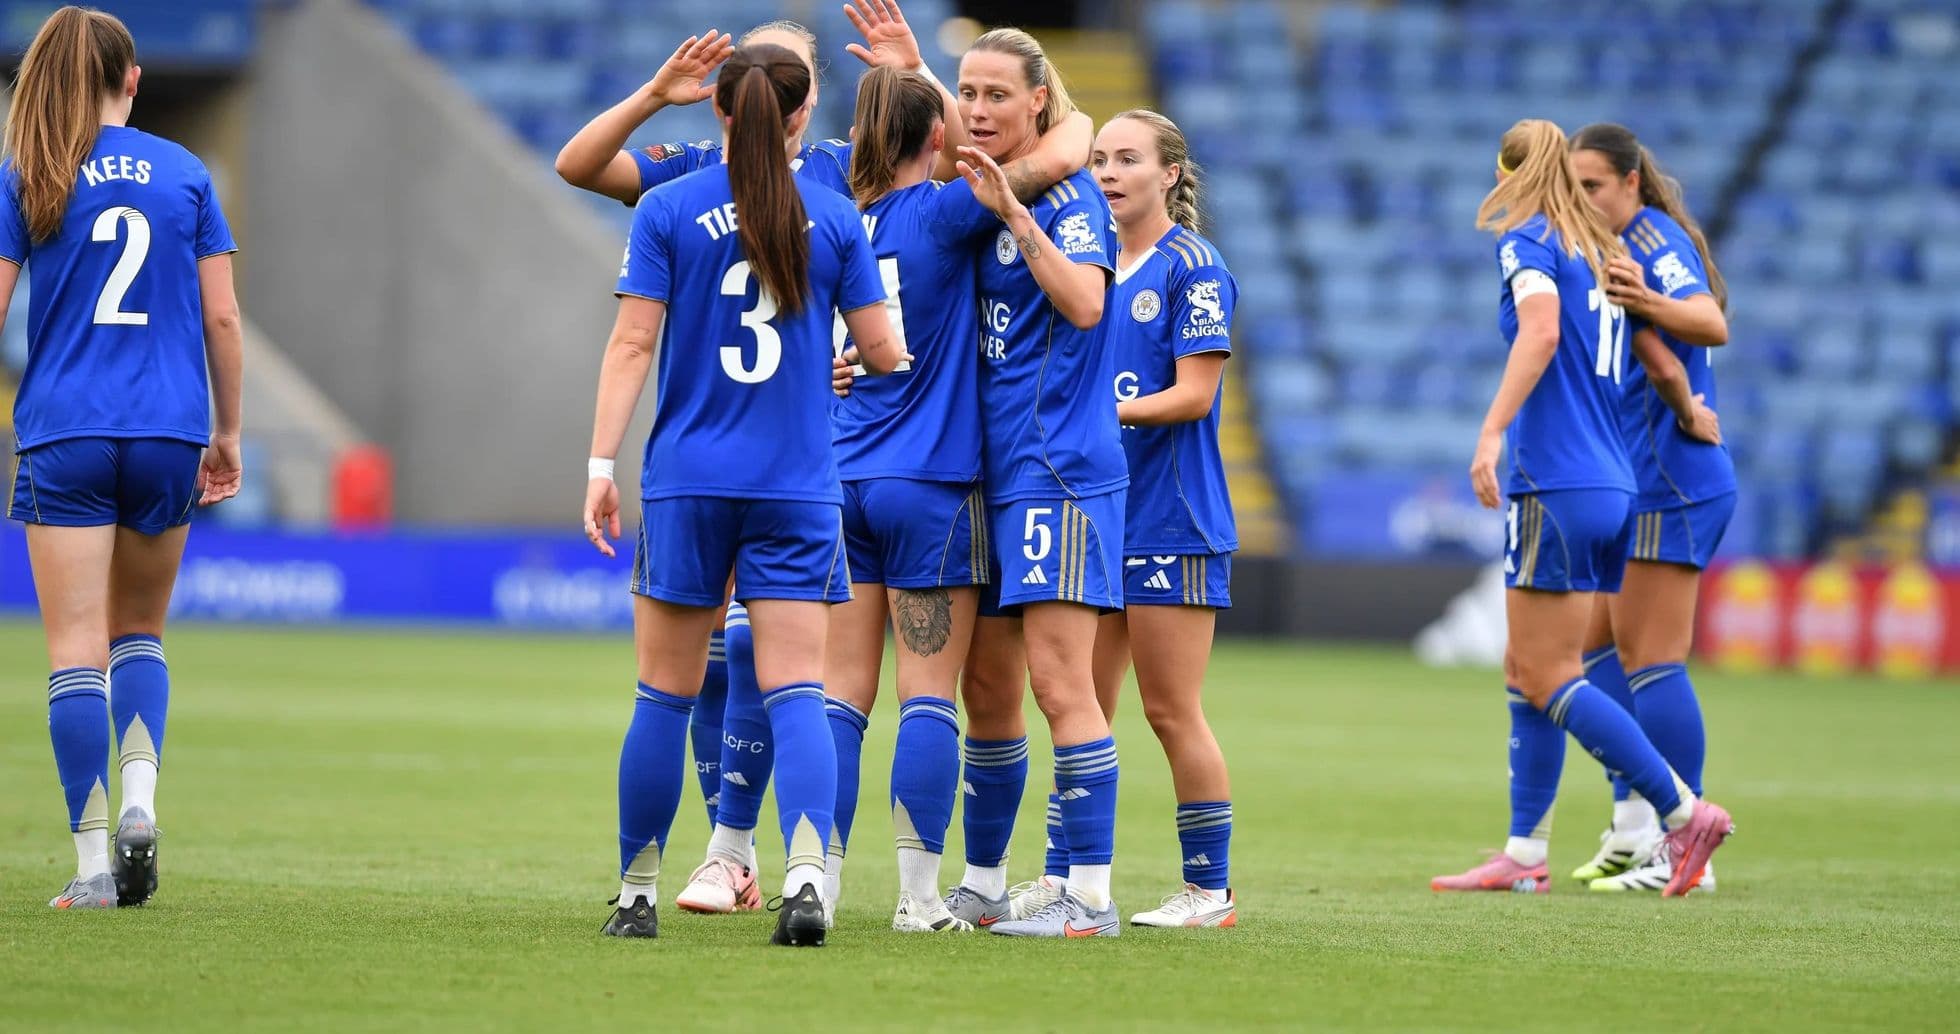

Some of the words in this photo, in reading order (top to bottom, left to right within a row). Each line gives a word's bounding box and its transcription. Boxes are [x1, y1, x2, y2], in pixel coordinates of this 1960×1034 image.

[80, 155, 152, 187] KEES
[1061, 244, 1104, 255] AIGON
[92, 206, 151, 325] 2
[719, 260, 782, 384] 3
[1182, 324, 1229, 339] SAIGON
[1199, 317, 1214, 325] BIA
[1023, 508, 1053, 560] 5
[723, 730, 765, 753] LCFC
